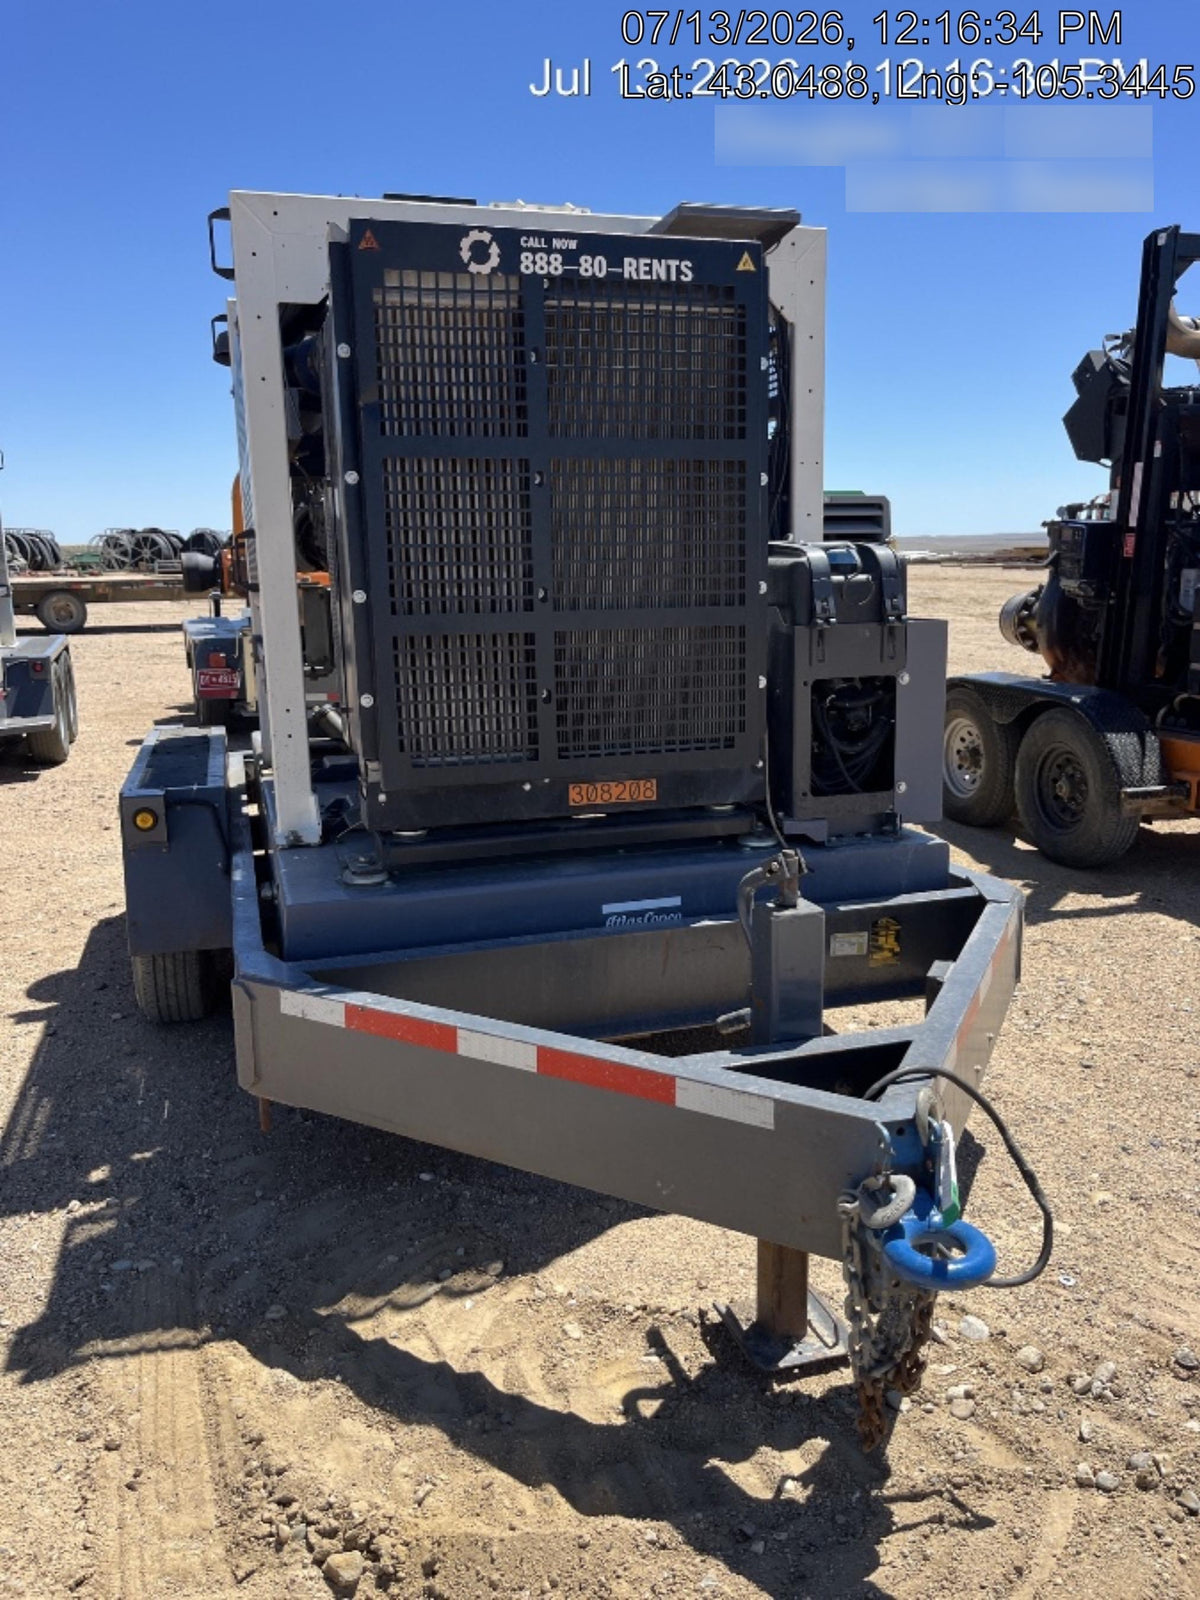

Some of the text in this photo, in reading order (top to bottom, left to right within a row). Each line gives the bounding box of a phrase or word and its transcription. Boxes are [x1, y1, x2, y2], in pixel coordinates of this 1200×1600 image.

[520, 236, 578, 250] CALL NOW
[571, 780, 655, 804] 308208
